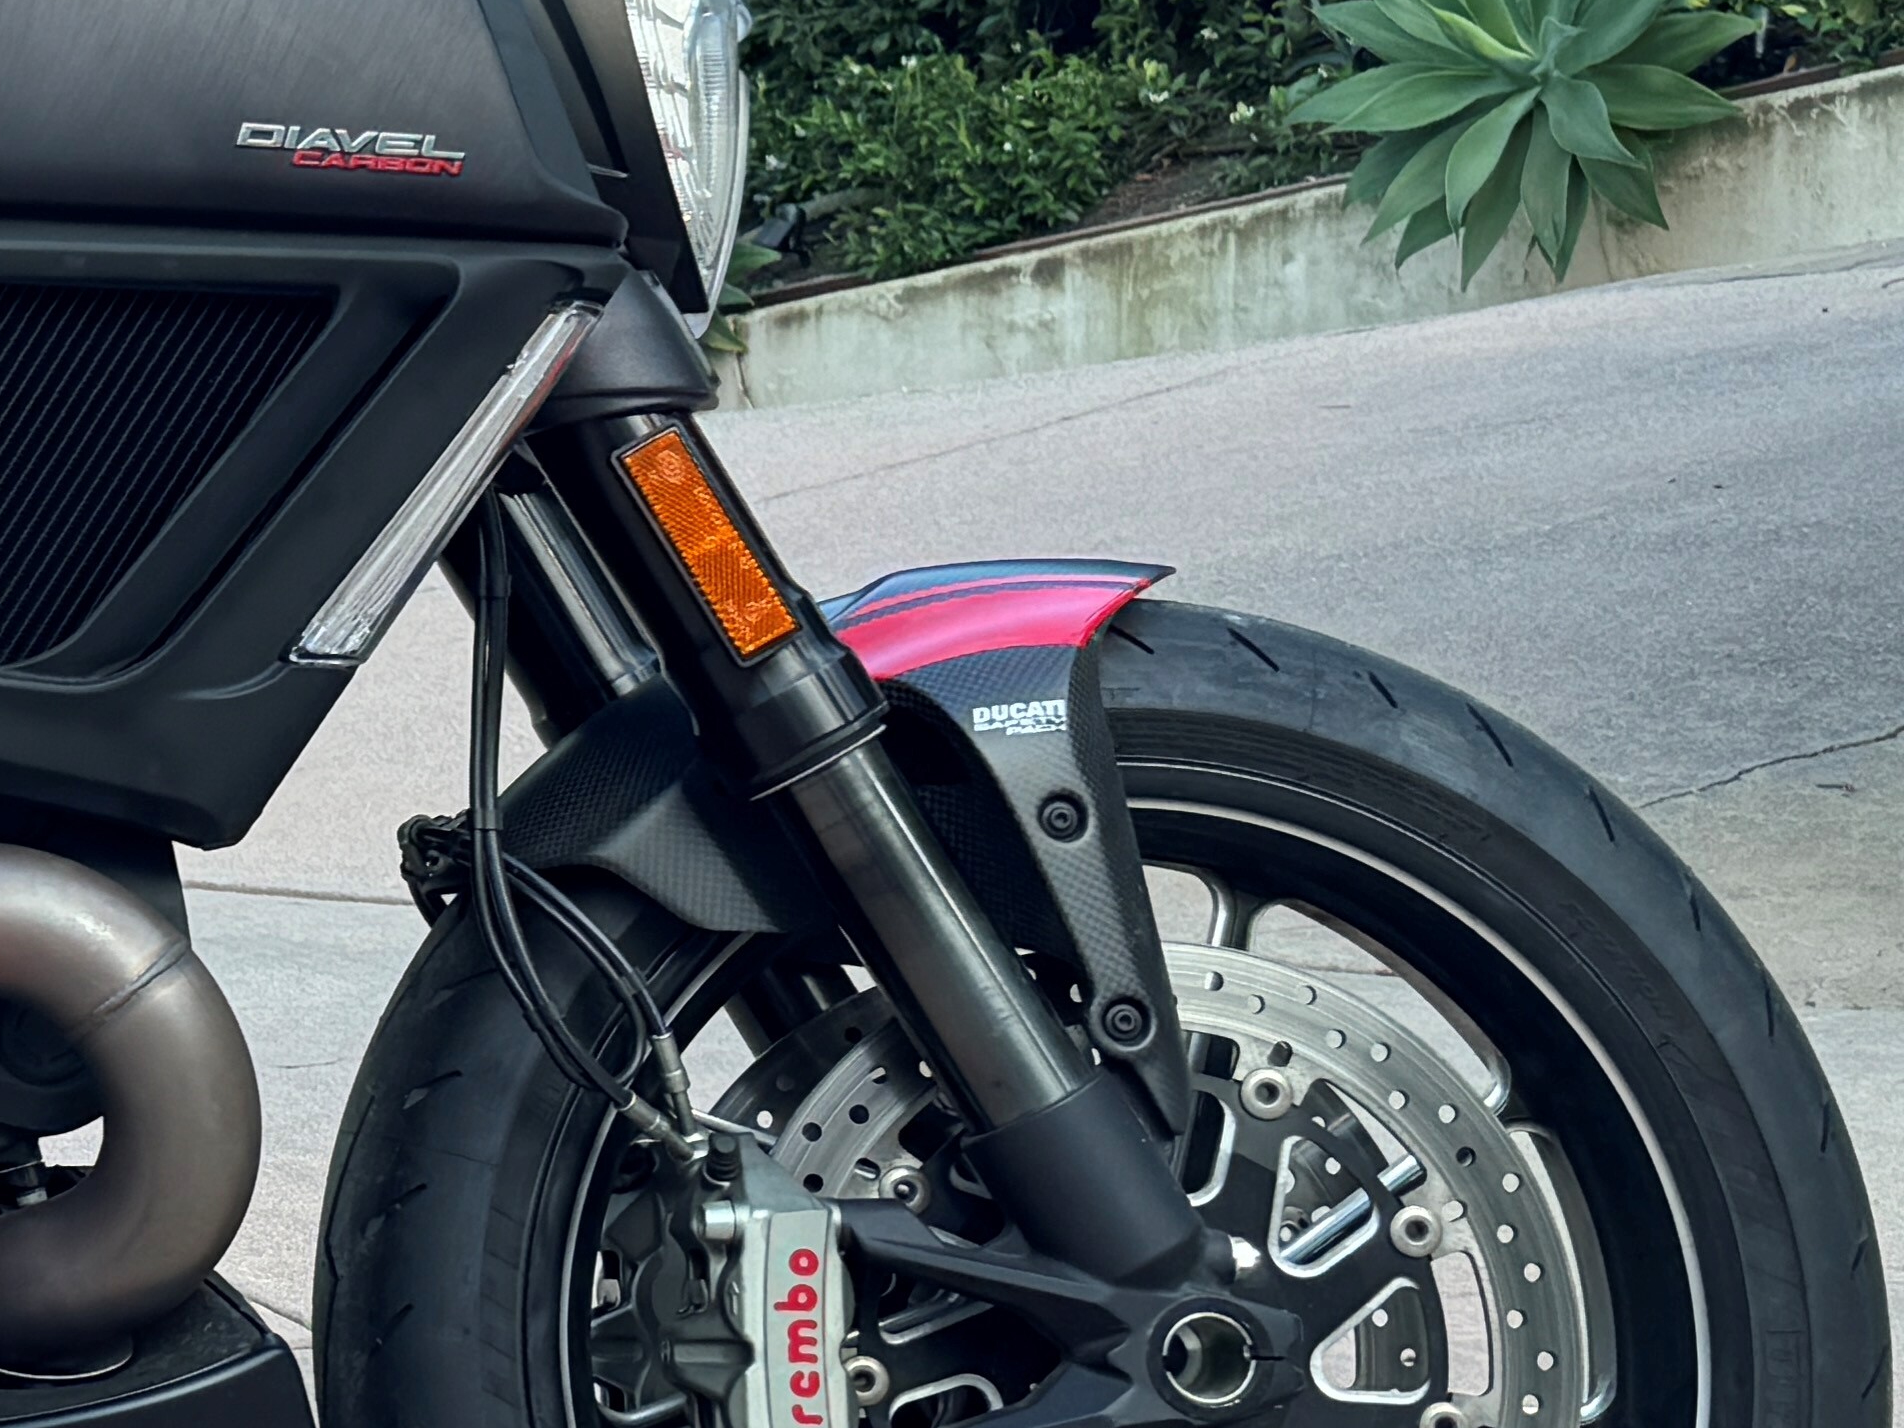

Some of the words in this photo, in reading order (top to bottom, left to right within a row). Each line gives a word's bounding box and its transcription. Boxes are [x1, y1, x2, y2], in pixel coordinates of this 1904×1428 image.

[236, 122, 466, 159] DIAVEL
[293, 150, 464, 176] CARBON
[972, 699, 1068, 724] DUCATI
